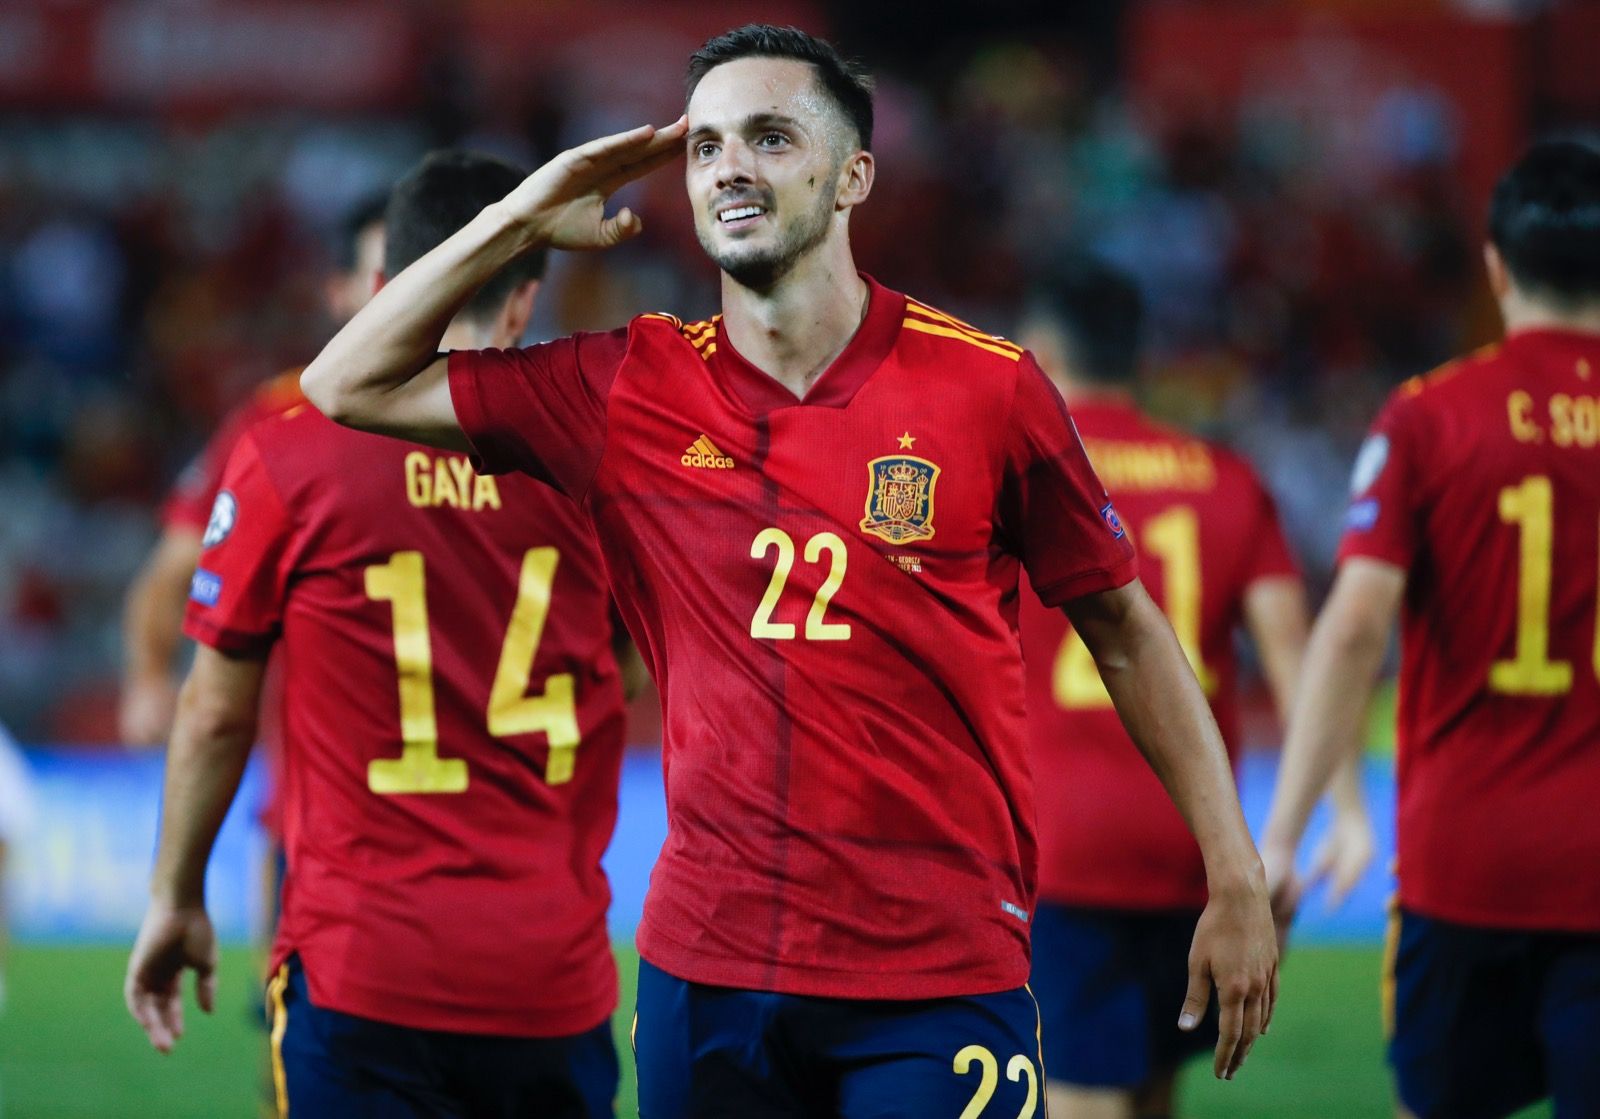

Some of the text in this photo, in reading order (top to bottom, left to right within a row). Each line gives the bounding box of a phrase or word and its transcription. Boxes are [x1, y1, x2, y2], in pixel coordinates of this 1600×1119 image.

[404, 451, 502, 511] GAYA
[681, 453, 735, 469] adidas
[750, 527, 851, 641] 22
[364, 546, 581, 794] 14
[953, 1044, 1038, 1119] 22
